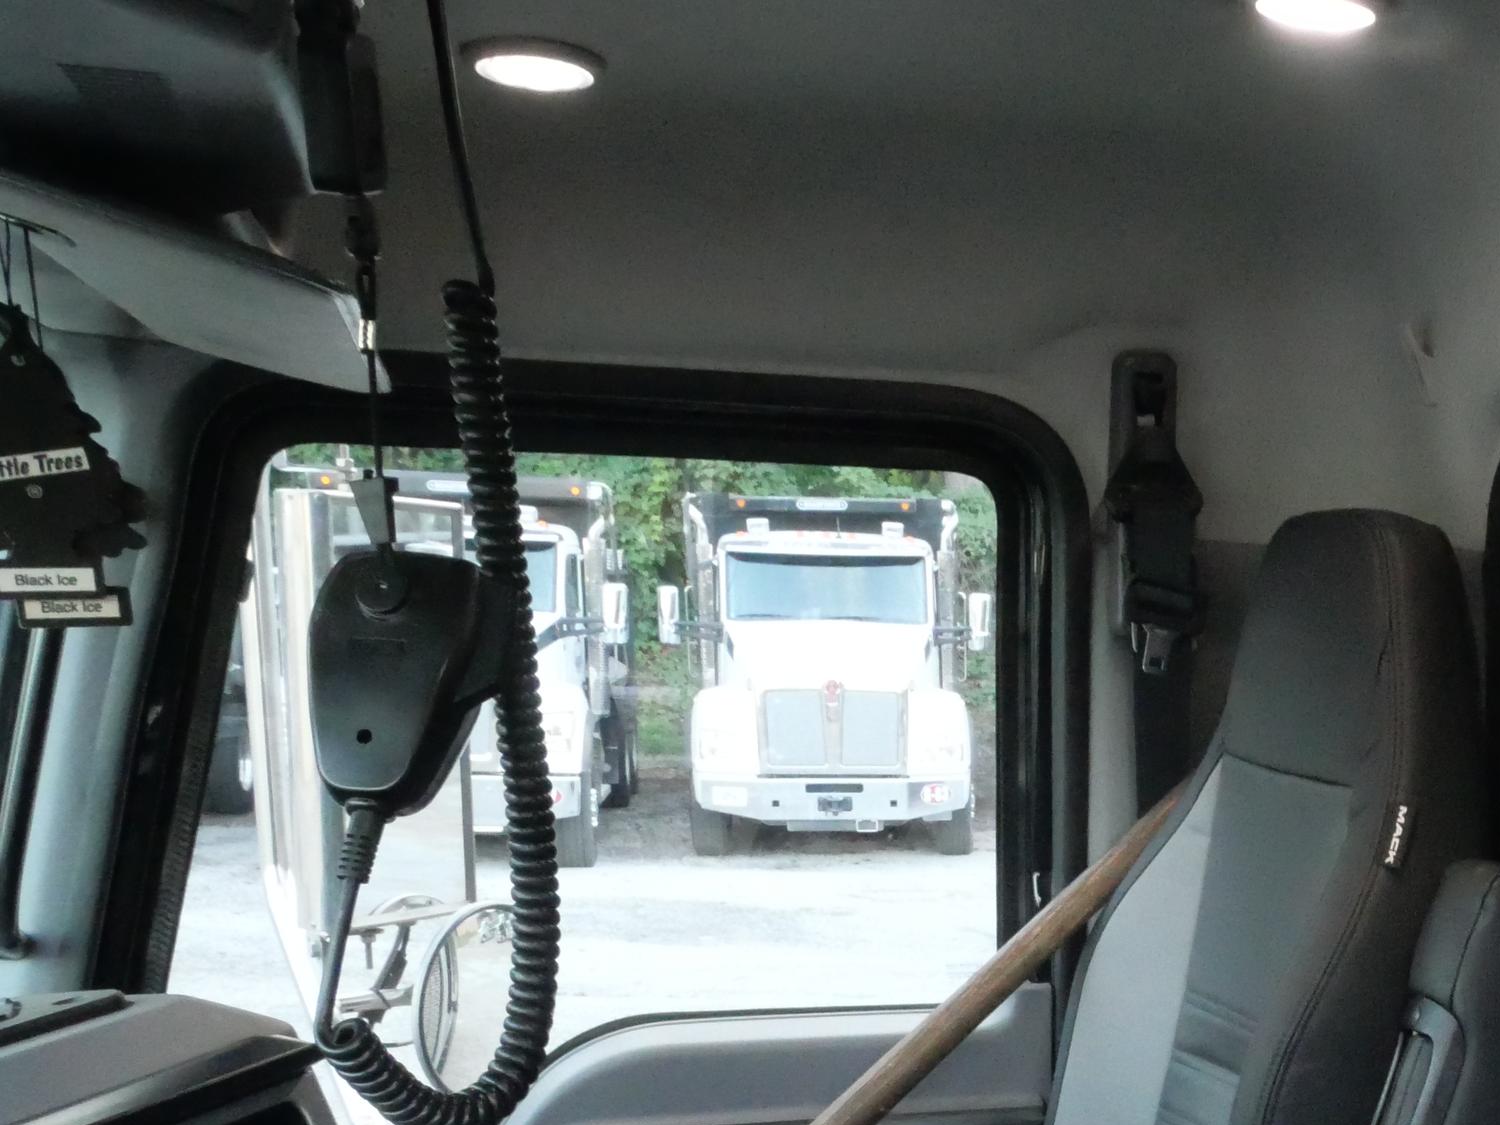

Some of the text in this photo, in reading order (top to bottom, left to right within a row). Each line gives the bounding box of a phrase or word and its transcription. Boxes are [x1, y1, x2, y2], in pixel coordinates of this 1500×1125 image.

[33, 453, 83, 473] Trees
[14, 573, 78, 586] Black Ice
[41, 600, 103, 614] Black Ice
[1384, 805, 1408, 864] MACK
